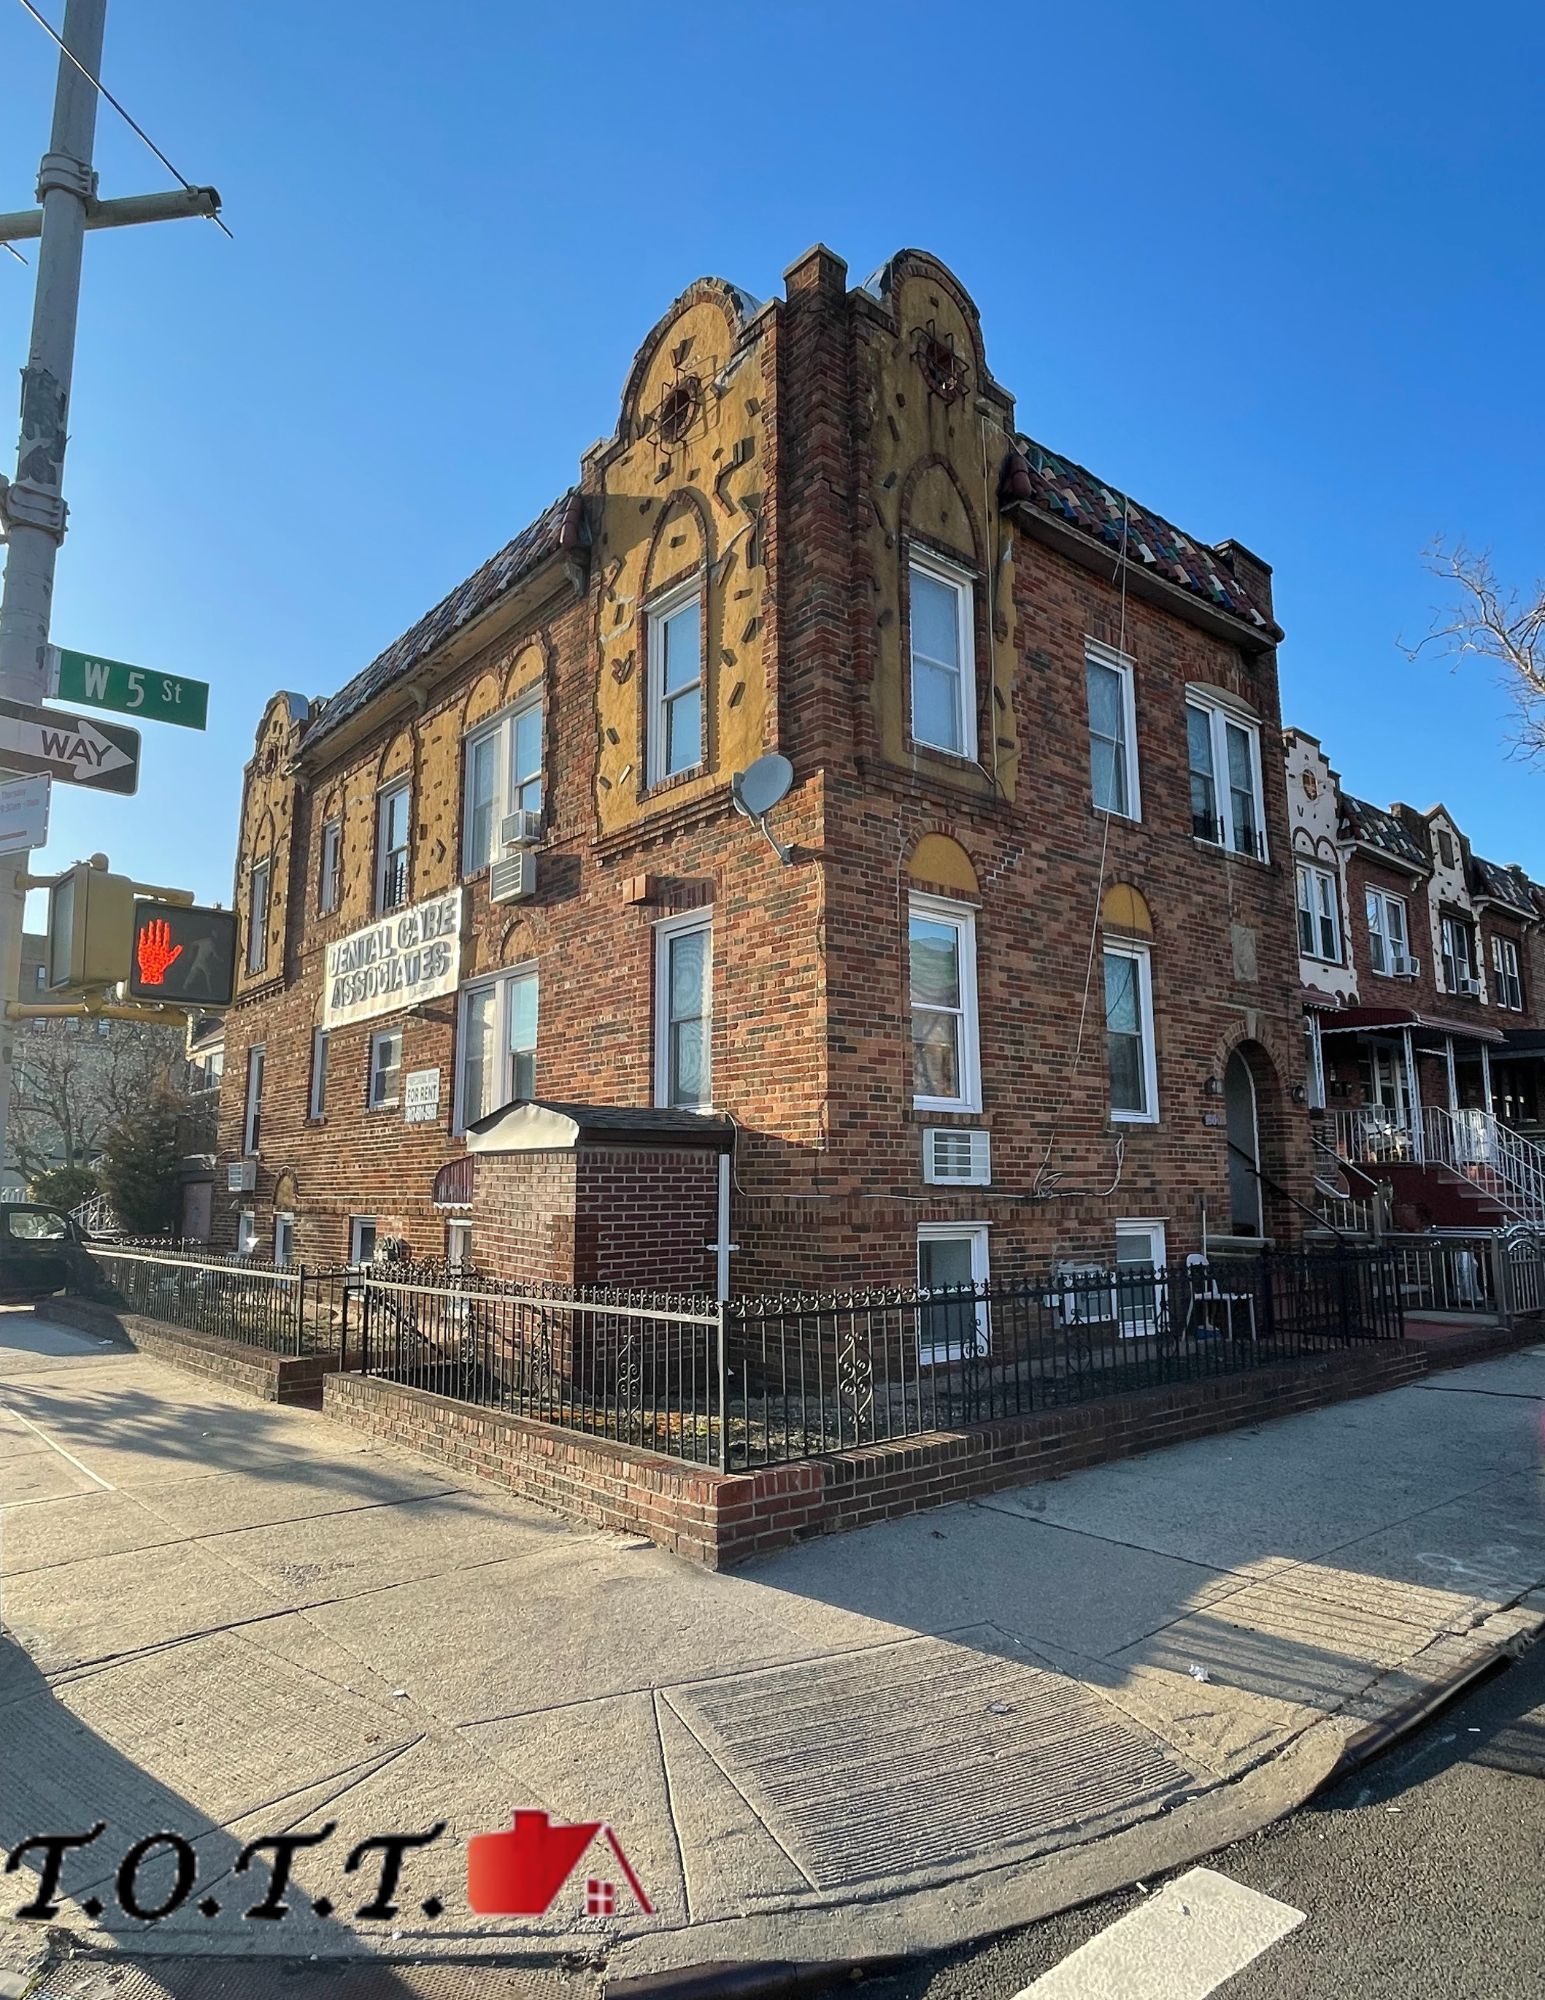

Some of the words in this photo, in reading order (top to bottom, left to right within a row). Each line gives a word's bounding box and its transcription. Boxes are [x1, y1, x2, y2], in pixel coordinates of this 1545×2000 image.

[84, 661, 110, 700] W
[126, 671, 145, 708] 5
[161, 679, 182, 704] St
[41, 730, 113, 767] WAY
[329, 925, 397, 977] DENTAL
[397, 897, 457, 949] CARE
[331, 941, 452, 1009] ASSOCIATES
[407, 1087, 419, 1103] FOR
[420, 1084, 437, 1101] RENT
